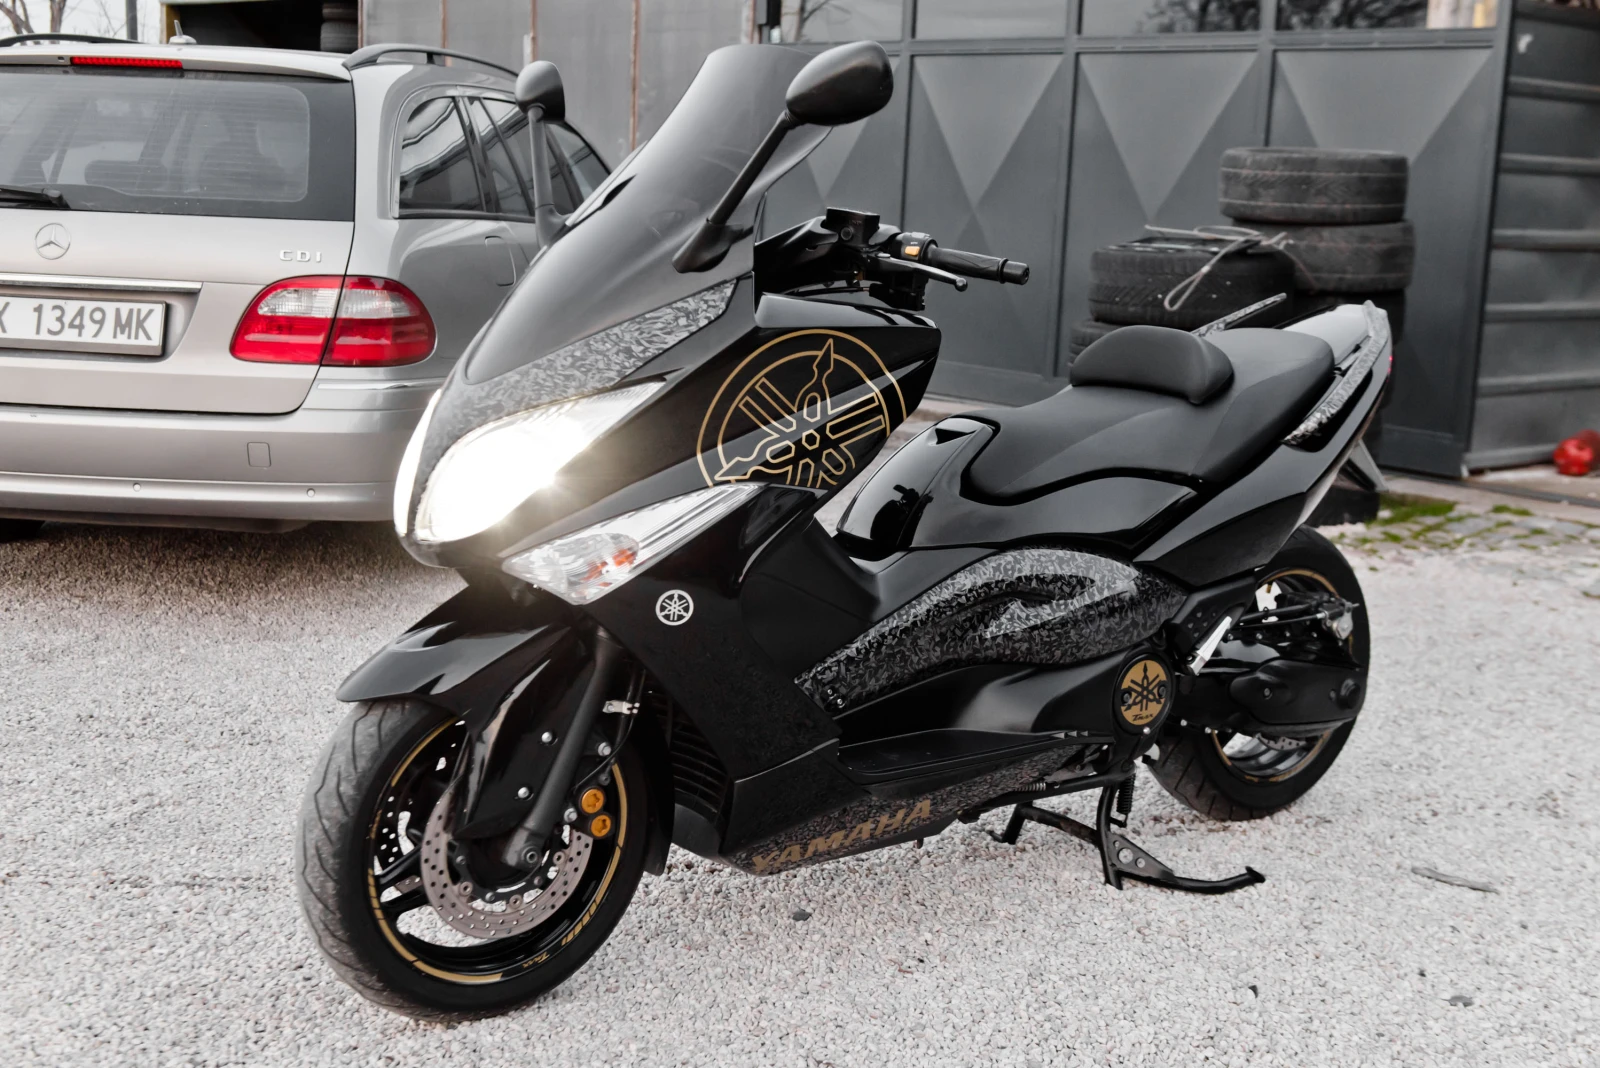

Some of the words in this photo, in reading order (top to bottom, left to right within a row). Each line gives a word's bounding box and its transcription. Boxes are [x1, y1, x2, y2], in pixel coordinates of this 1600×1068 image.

[279, 249, 322, 263] CDI
[32, 303, 107, 338] 1349
[112, 307, 155, 341] MK
[752, 799, 932, 873] YAMAHA
